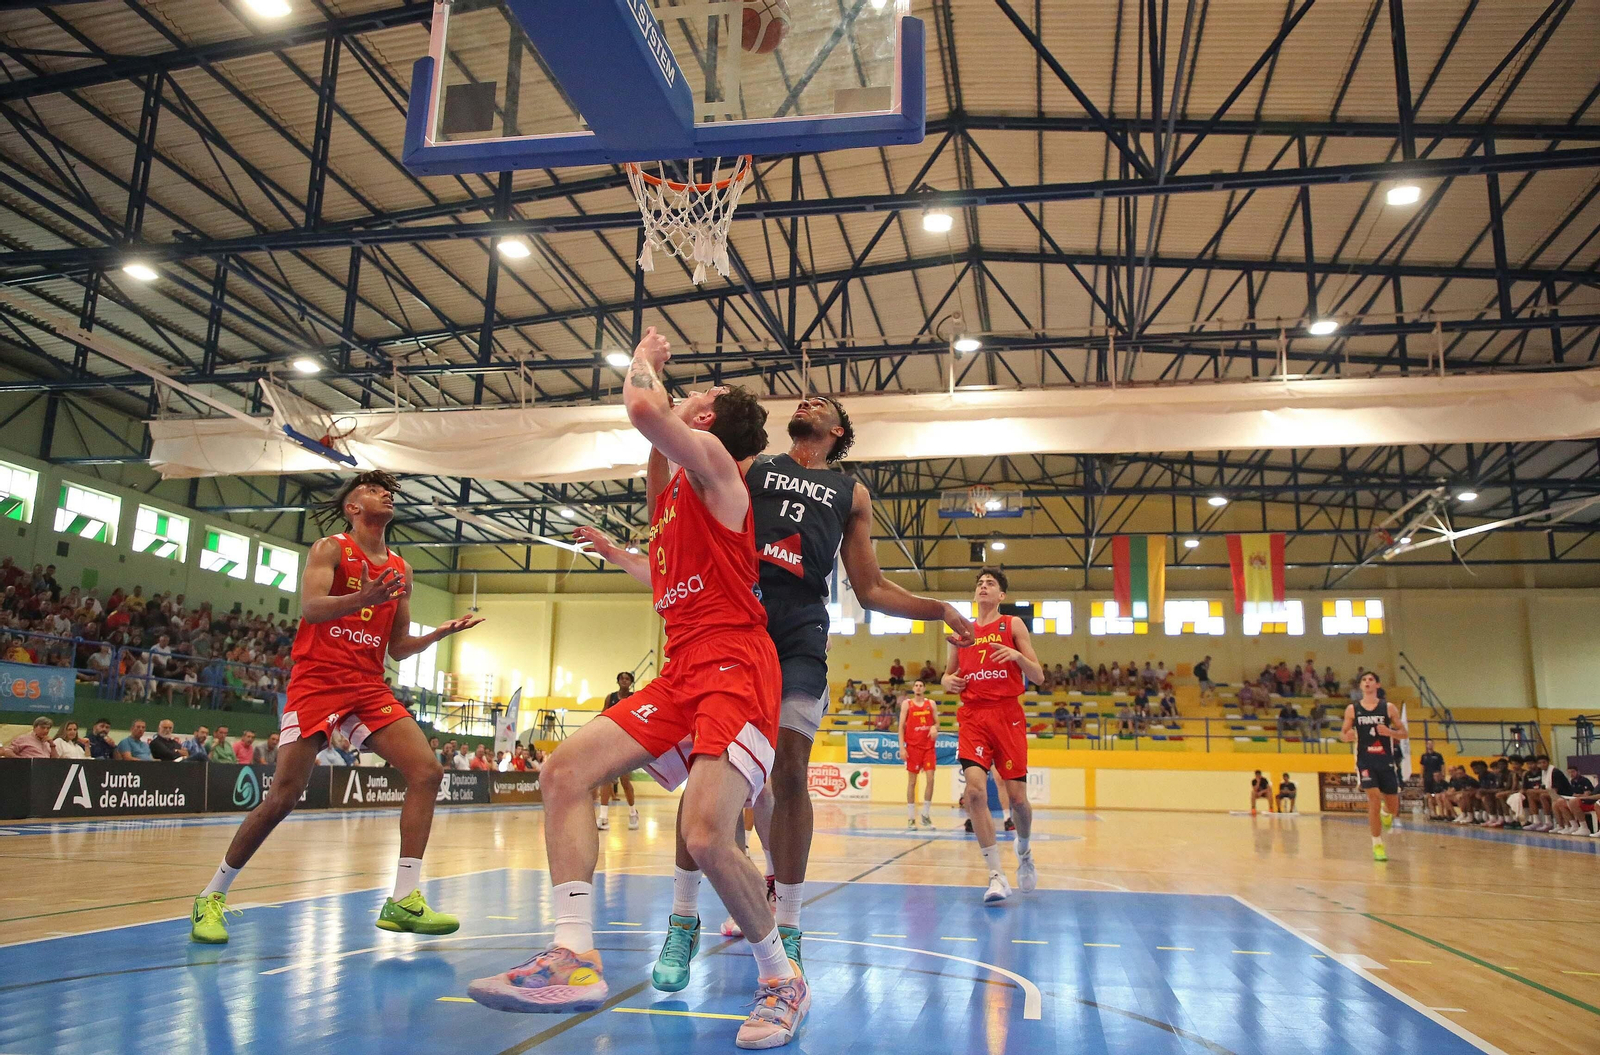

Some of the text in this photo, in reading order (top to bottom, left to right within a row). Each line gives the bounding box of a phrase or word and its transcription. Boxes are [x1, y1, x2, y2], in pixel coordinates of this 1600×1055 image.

[763, 471, 838, 508] FRANCE
[780, 499, 806, 523] 13
[656, 546, 667, 576] 9
[763, 543, 803, 565] MAIF
[654, 573, 705, 611] ndesa
[329, 626, 382, 648] endes
[978, 649, 987, 664] 7
[963, 668, 1008, 683] endesa
[1357, 715, 1386, 726] FRANCE
[1369, 726, 1377, 737] 4
[881, 750, 894, 760] de
[100, 771, 141, 788] Junta
[366, 775, 388, 788] Junta
[451, 773, 478, 787] Diputación
[100, 787, 186, 808] de Andalucía
[366, 788, 408, 802] de Andaluc
[452, 789, 459, 801] de
